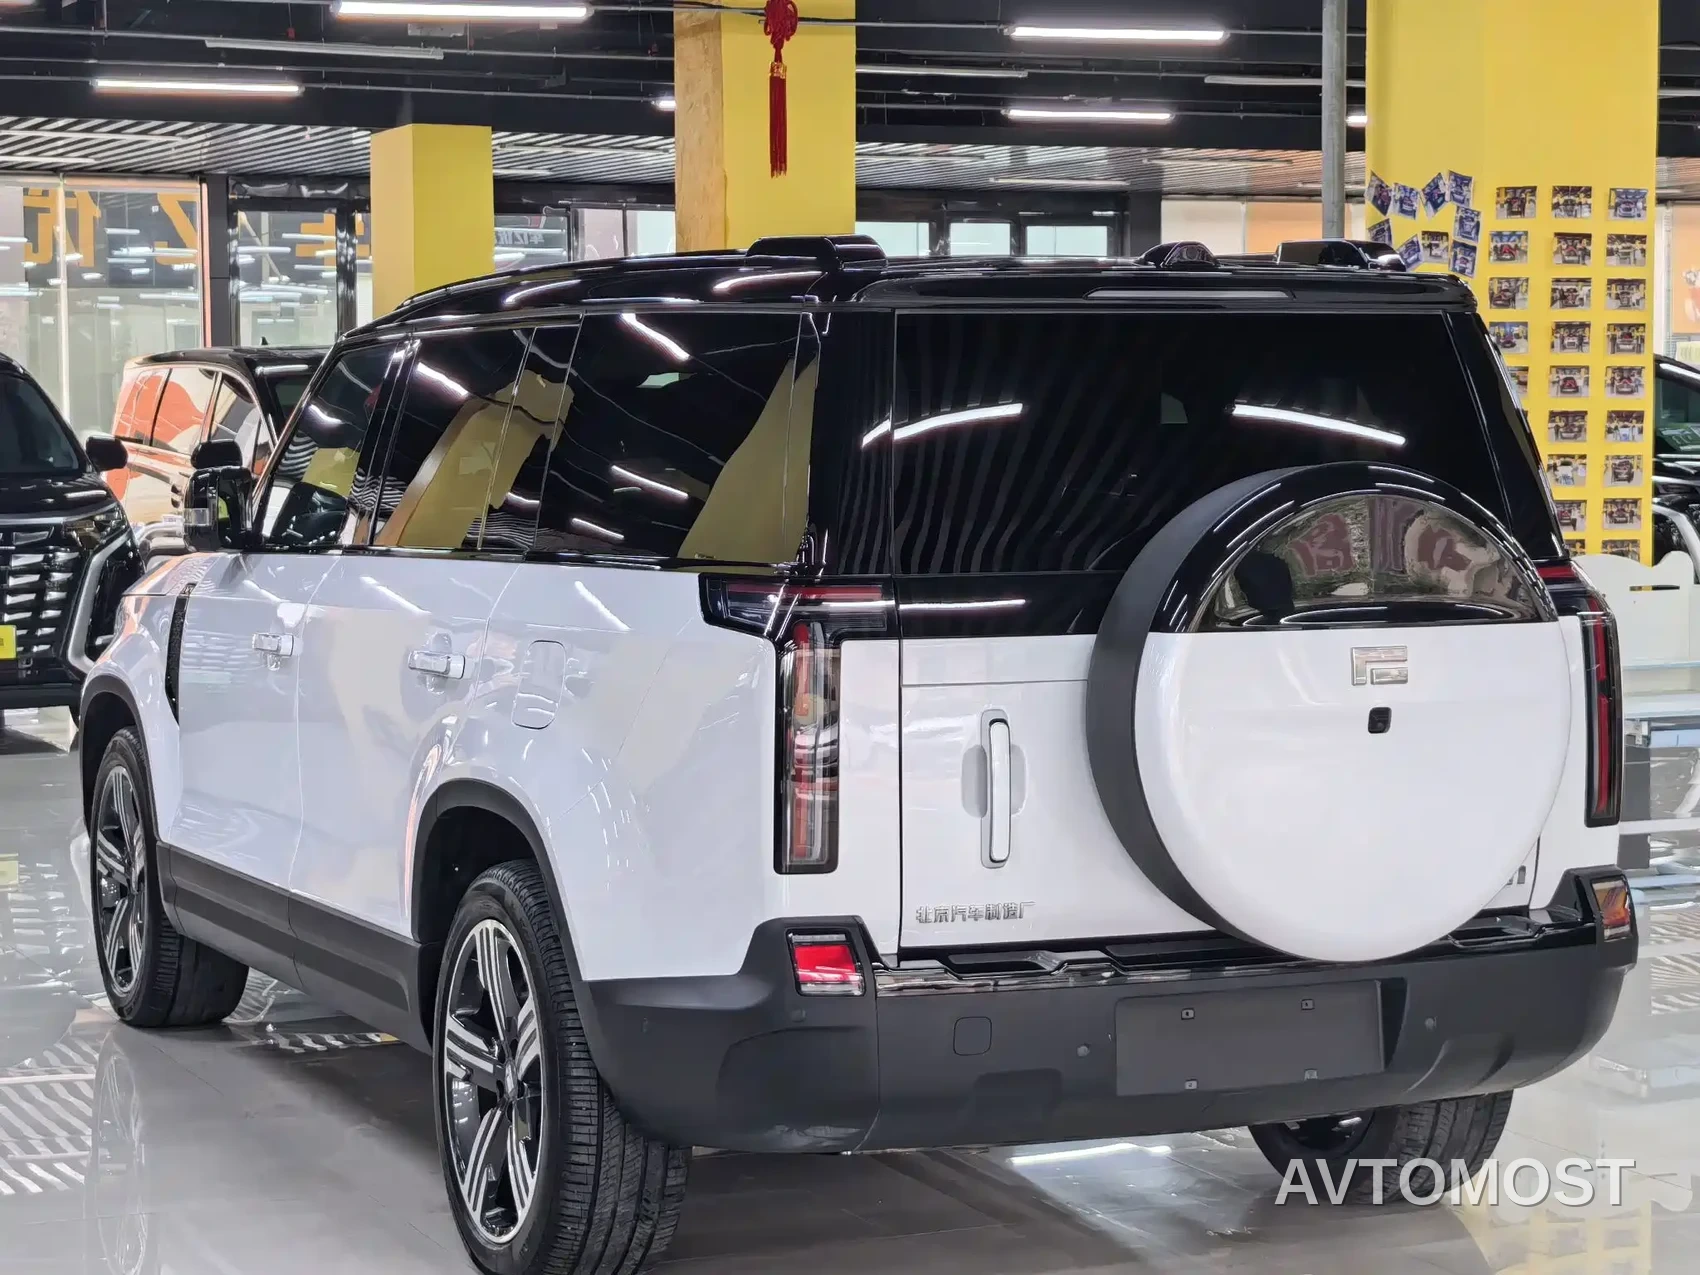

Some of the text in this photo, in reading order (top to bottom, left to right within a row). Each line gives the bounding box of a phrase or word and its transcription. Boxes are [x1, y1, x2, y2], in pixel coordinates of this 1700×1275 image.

[916, 900, 1036, 924] 北京汽车制造厂
